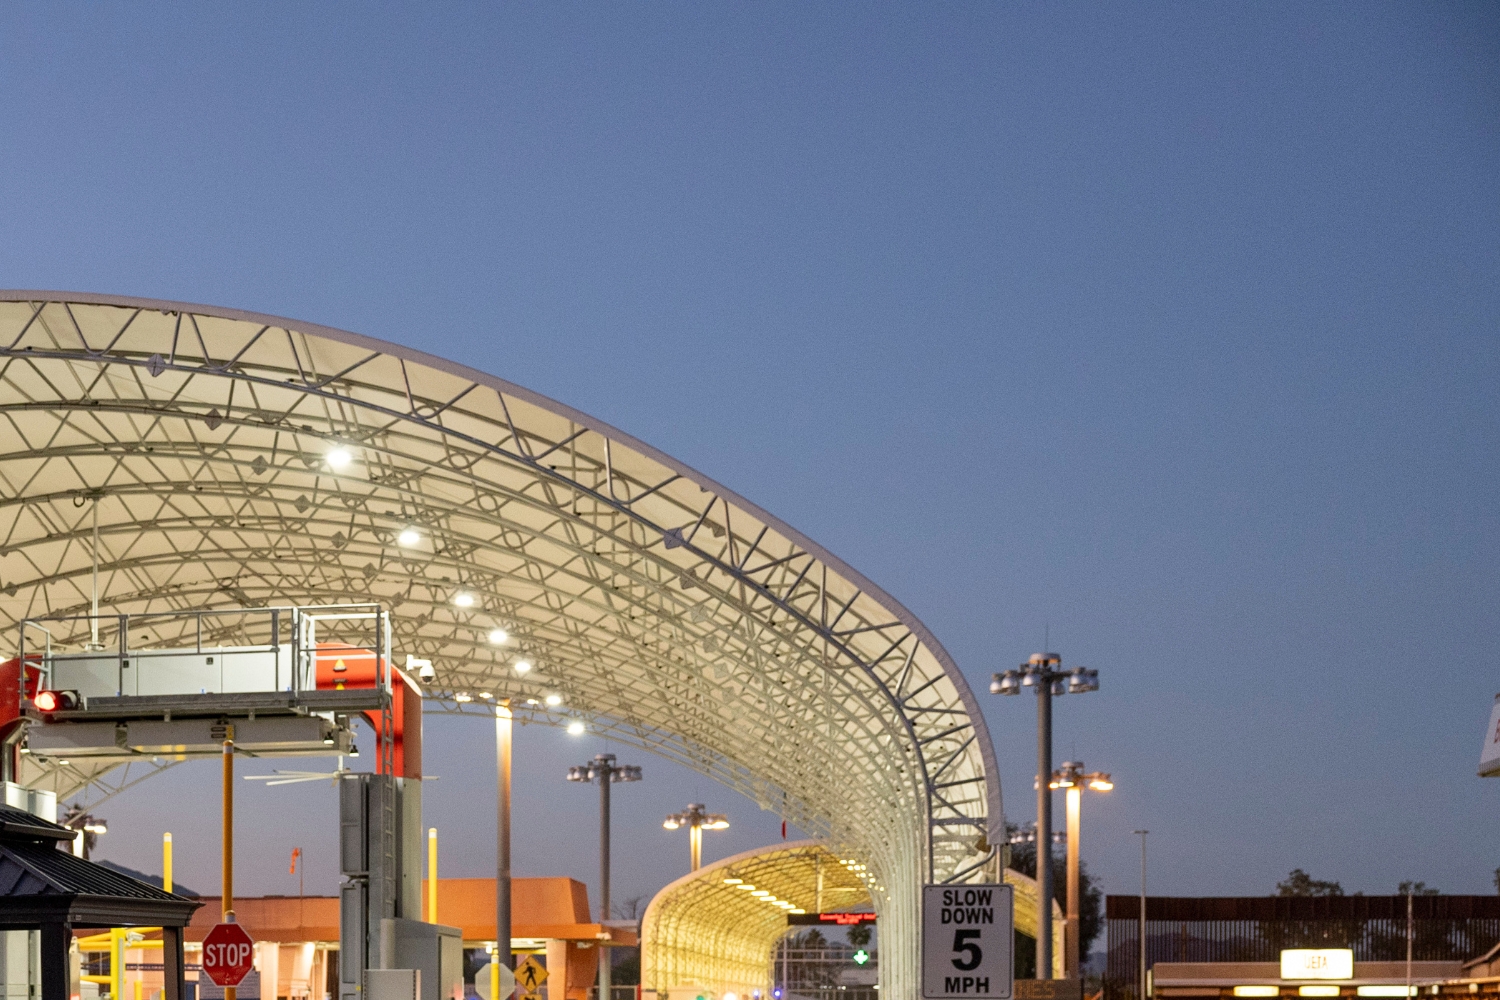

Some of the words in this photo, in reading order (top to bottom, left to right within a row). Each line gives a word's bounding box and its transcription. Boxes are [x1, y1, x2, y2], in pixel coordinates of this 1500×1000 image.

[943, 889, 993, 906] SLOW
[941, 907, 994, 924] DOWN
[205, 943, 250, 967] STOP
[951, 929, 982, 971] 5
[945, 977, 989, 993] MPH
